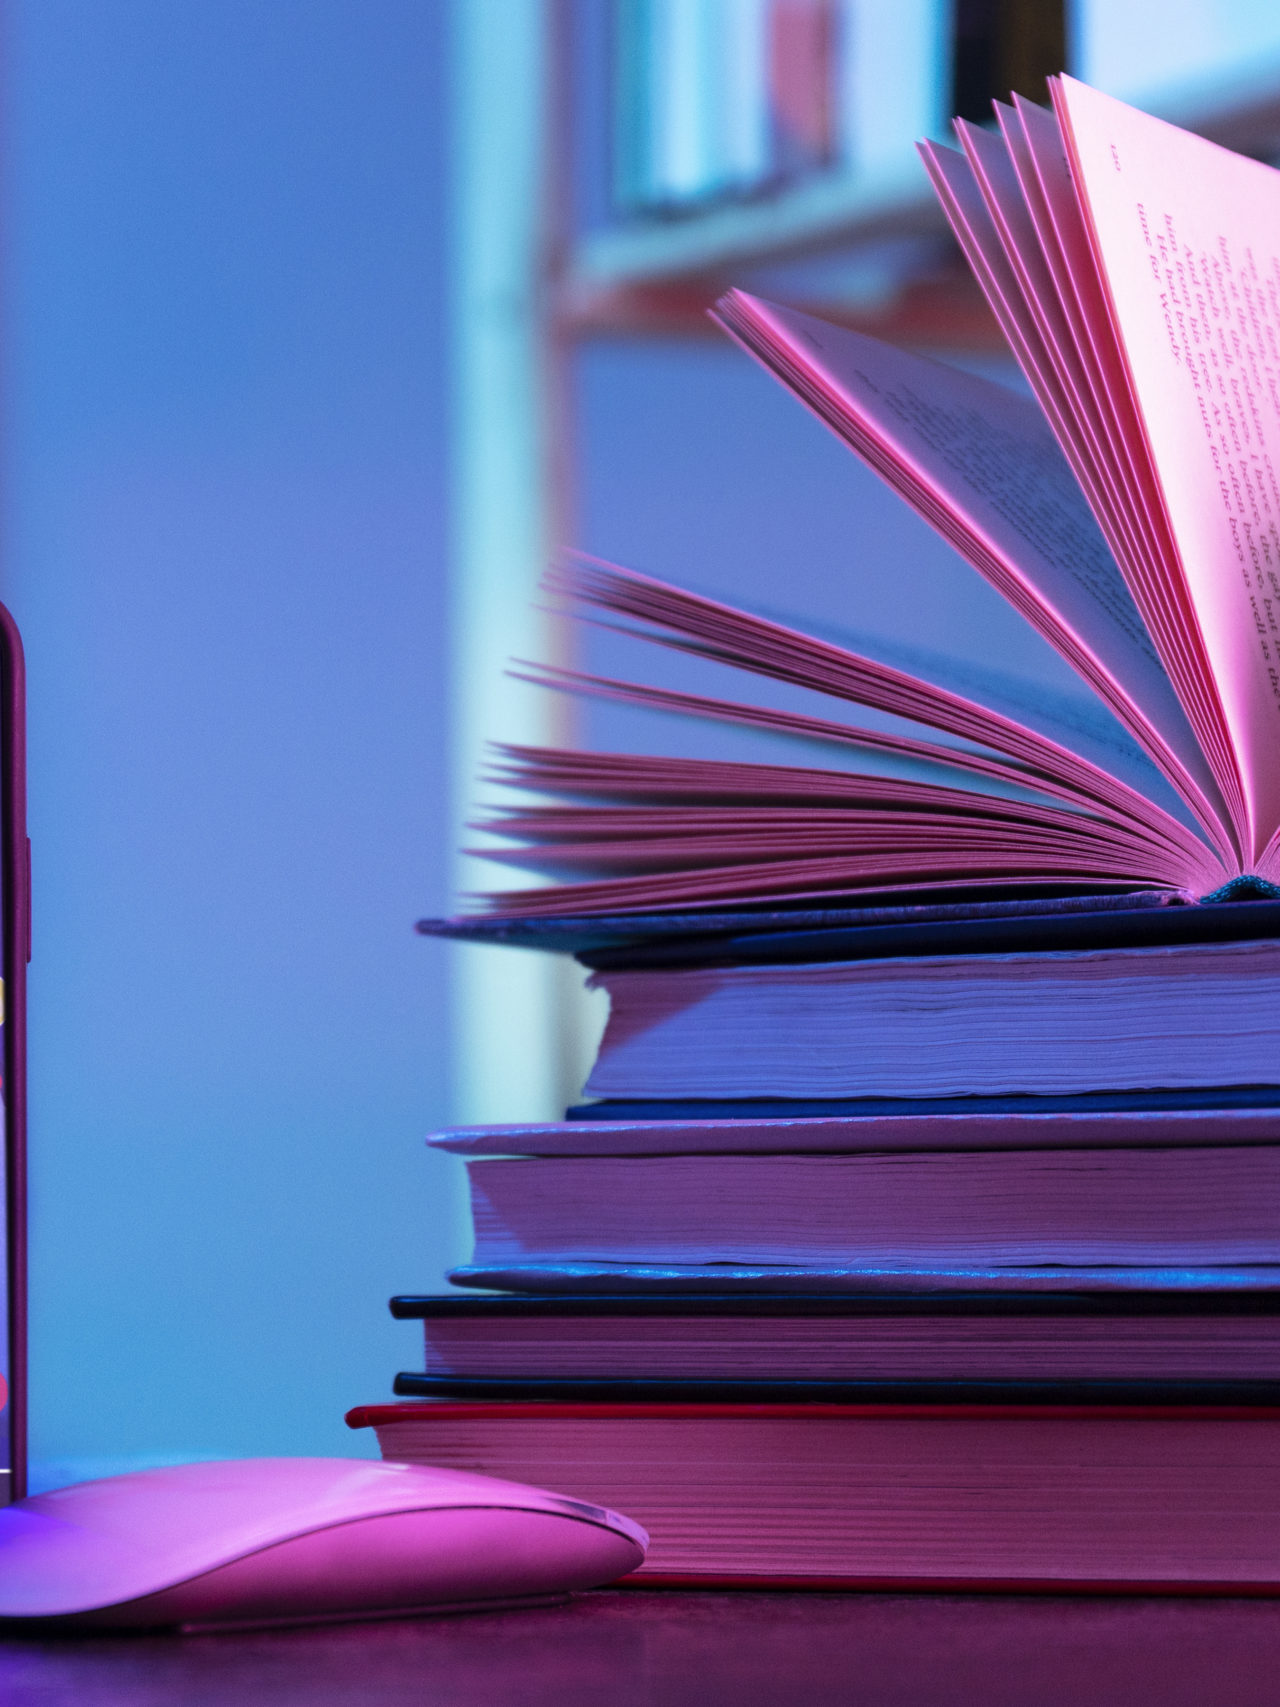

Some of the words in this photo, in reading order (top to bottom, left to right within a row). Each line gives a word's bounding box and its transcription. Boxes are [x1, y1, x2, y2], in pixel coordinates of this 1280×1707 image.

[1136, 202, 1152, 246] time
[1148, 254, 1161, 283] for
[1159, 292, 1181, 364] Wendy.
[1217, 235, 1232, 273] him
[1229, 281, 1239, 299] at
[1236, 306, 1248, 336] the
[1156, 234, 1168, 262] He
[1164, 268, 1181, 304] had
[1175, 310, 1200, 389] brought
[1196, 395, 1212, 438] nuts
[1209, 444, 1222, 473] for
[1219, 480, 1231, 510] the
[1228, 517, 1244, 561] boys
[1241, 568, 1251, 587] as
[1249, 595, 1266, 634] well
[1260, 640, 1271, 660] as
[1163, 213, 1178, 252] him
[1175, 260, 1191, 308] from
[1188, 316, 1201, 343] his
[1197, 352, 1212, 392] tree.
[1210, 401, 1221, 426] As
[1219, 433, 1229, 455] so
[1227, 462, 1244, 513] often
[1242, 522, 1264, 589] before,
[1263, 598, 1277, 631] but
[1183, 244, 1201, 285] And
[1195, 293, 1211, 340] then,
[1215, 374, 1226, 395] so
[1223, 402, 1241, 451] often
[1238, 459, 1260, 525] before,
[1259, 535, 1272, 565] the
[1217, 327, 1234, 368] well,
[1229, 378, 1250, 443] braves,
[1253, 468, 1271, 512] have
[1229, 329, 1242, 359] the
[1239, 366, 1264, 445] redskins
